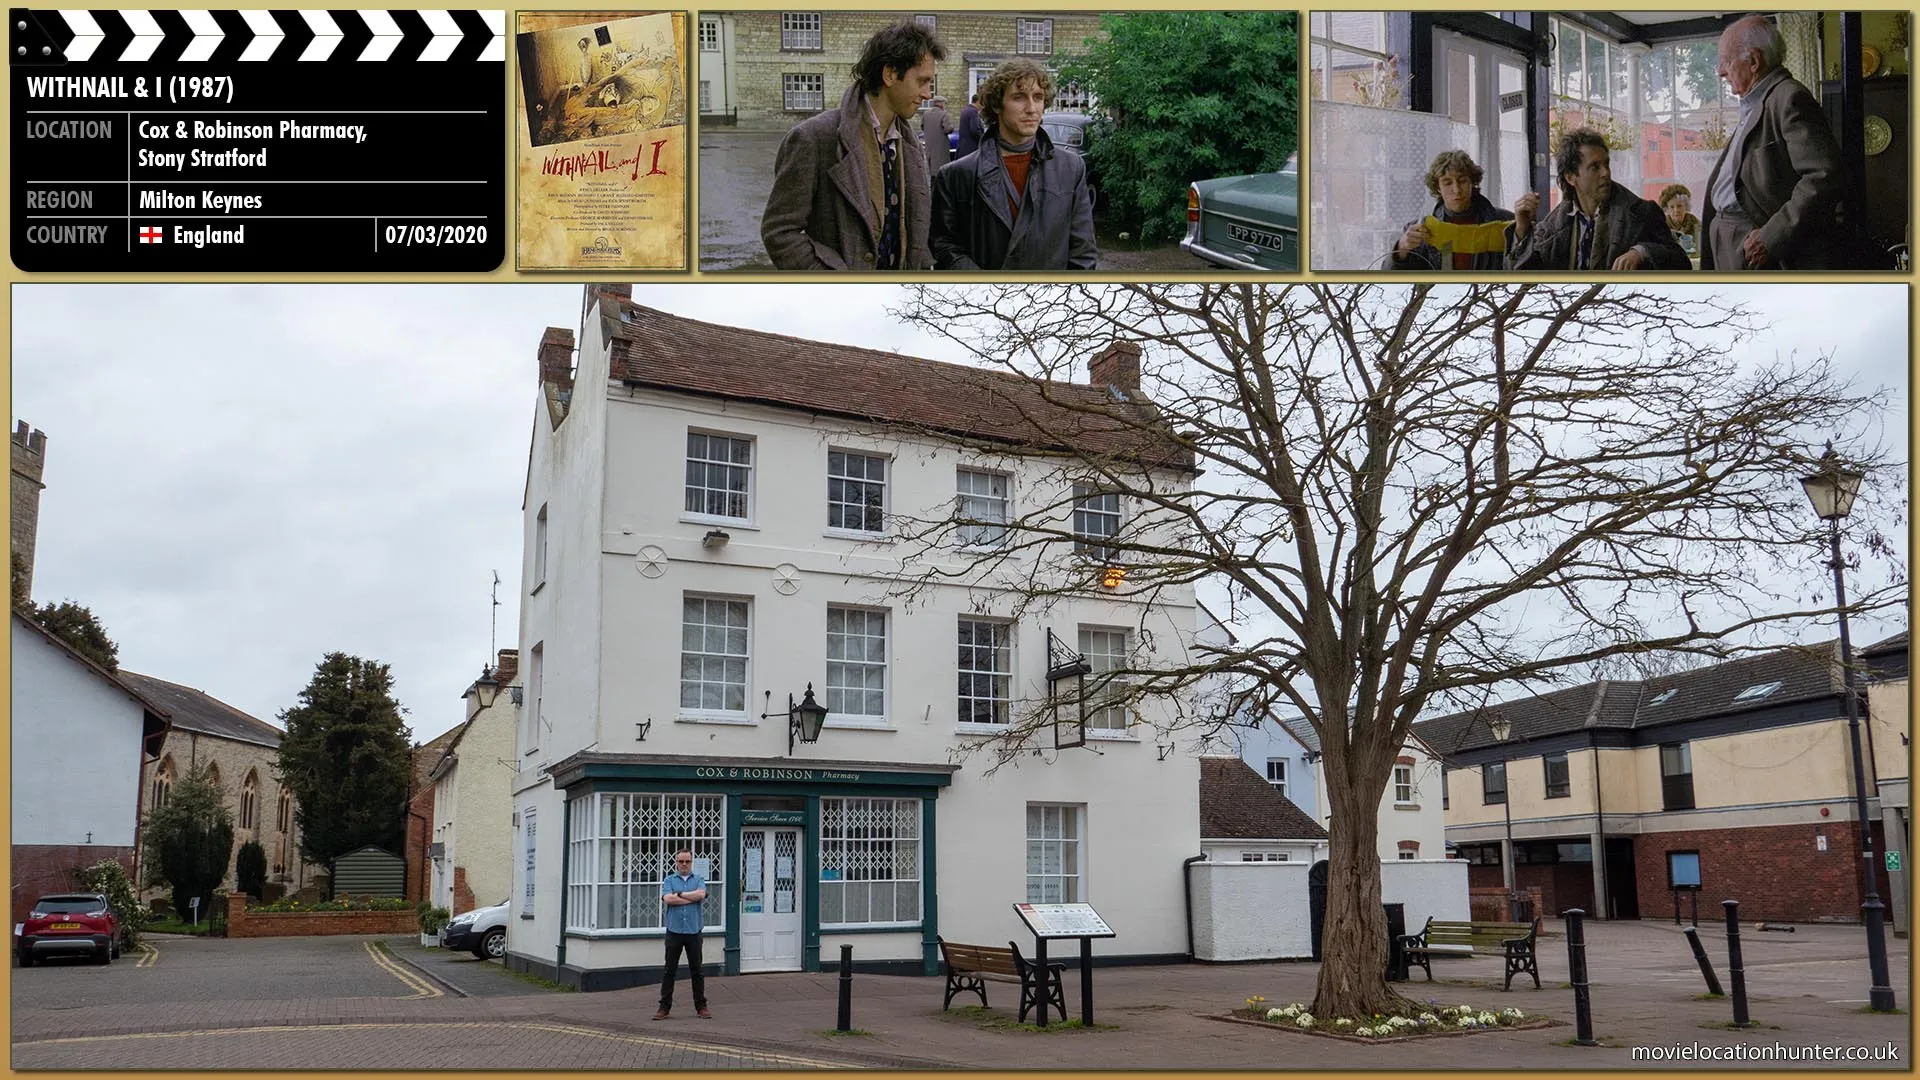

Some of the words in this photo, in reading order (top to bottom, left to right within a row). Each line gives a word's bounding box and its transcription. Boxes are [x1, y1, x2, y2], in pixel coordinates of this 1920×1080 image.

[1501, 94, 1523, 110] CLOSED
[542, 149, 618, 181] WITHNAIL
[1229, 225, 1249, 240] LPP
[1250, 231, 1281, 249] 977C
[696, 767, 724, 778] COX
[729, 767, 738, 778] &
[743, 768, 813, 780] ROBINSON
[822, 771, 860, 782] Pharmacy
[744, 813, 769, 822] Service
[769, 812, 788, 823] Since
